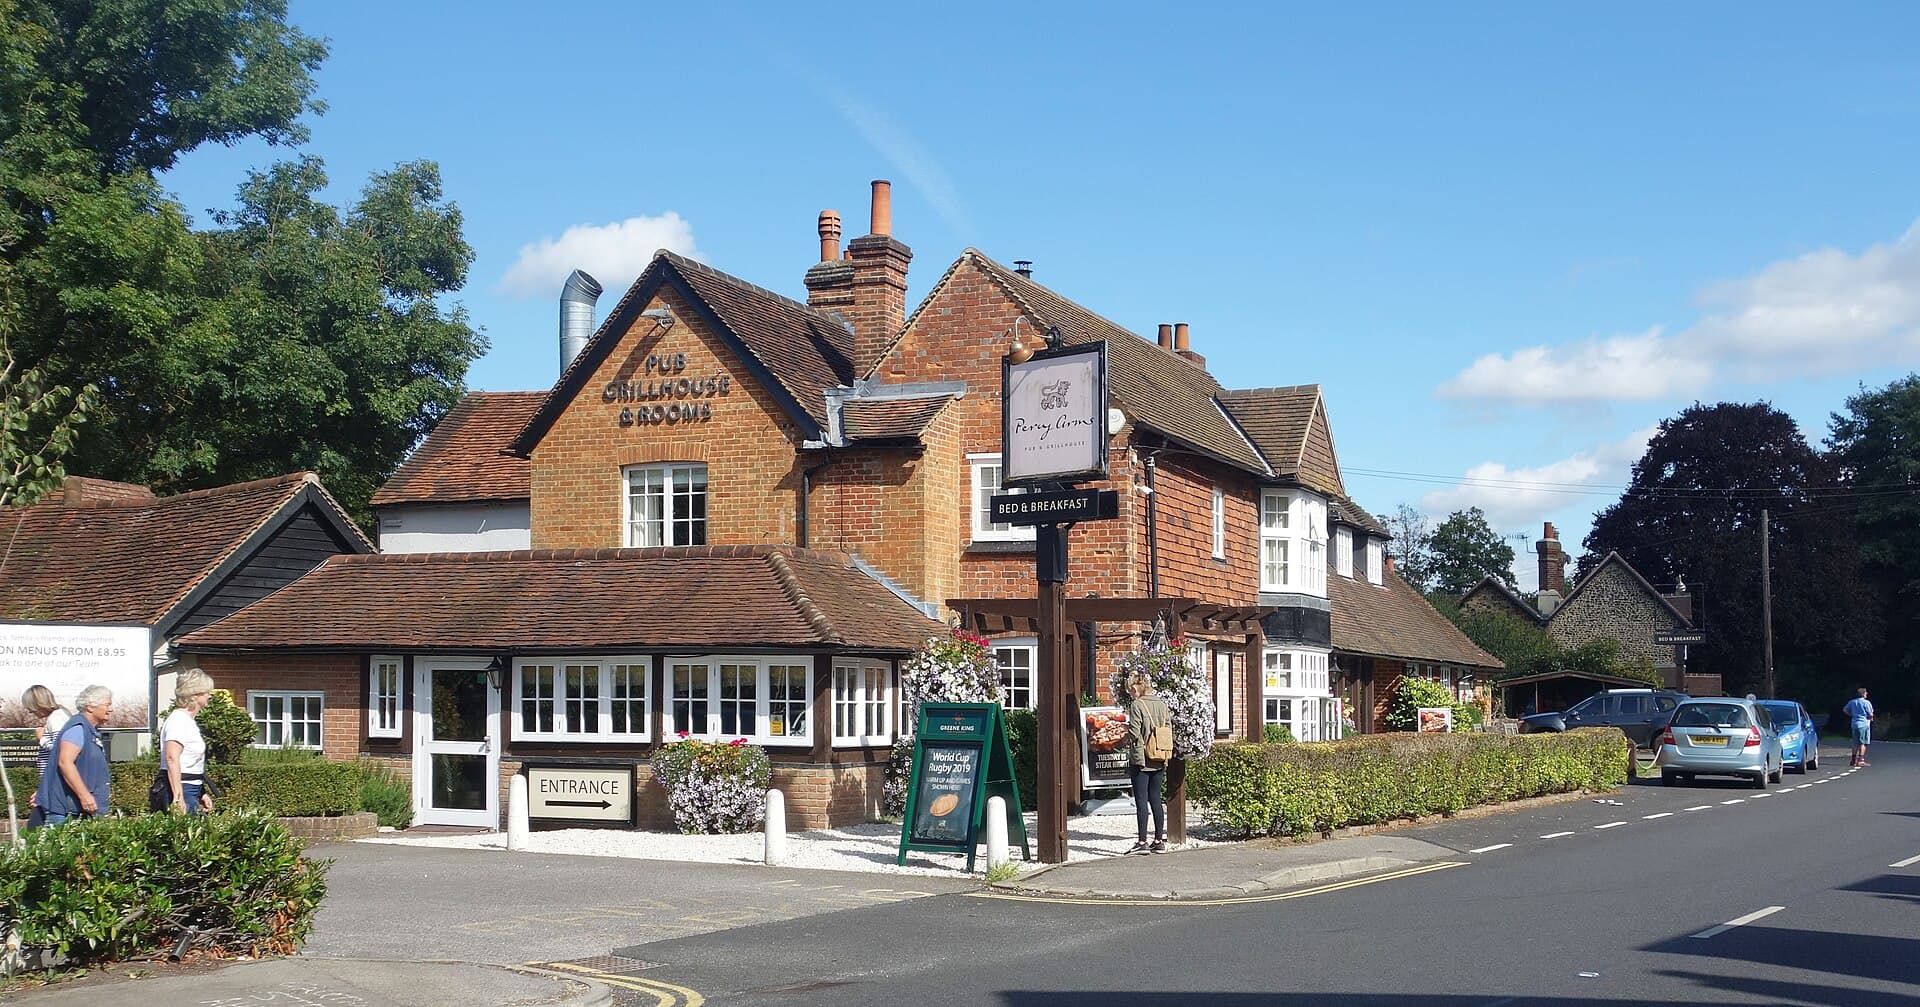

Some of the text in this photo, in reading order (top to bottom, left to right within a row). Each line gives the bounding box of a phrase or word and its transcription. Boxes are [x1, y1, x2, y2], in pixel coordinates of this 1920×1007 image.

[646, 352, 686, 374] PUB
[603, 375, 730, 402] GRILLHOUSE
[620, 402, 712, 427] & ROOMS
[1015, 417, 1051, 440] Percy
[999, 498, 1088, 514] BED & BREAKFAST
[17, 646, 58, 656] MENUS
[61, 647, 94, 656] FROM
[97, 648, 126, 657] £8.95
[75, 660, 100, 668] Team
[933, 752, 970, 764] World Cup
[1097, 753, 1120, 761] TUESDAY
[928, 762, 971, 774] Rugby 2019
[540, 779, 619, 795] ENTRANCE
